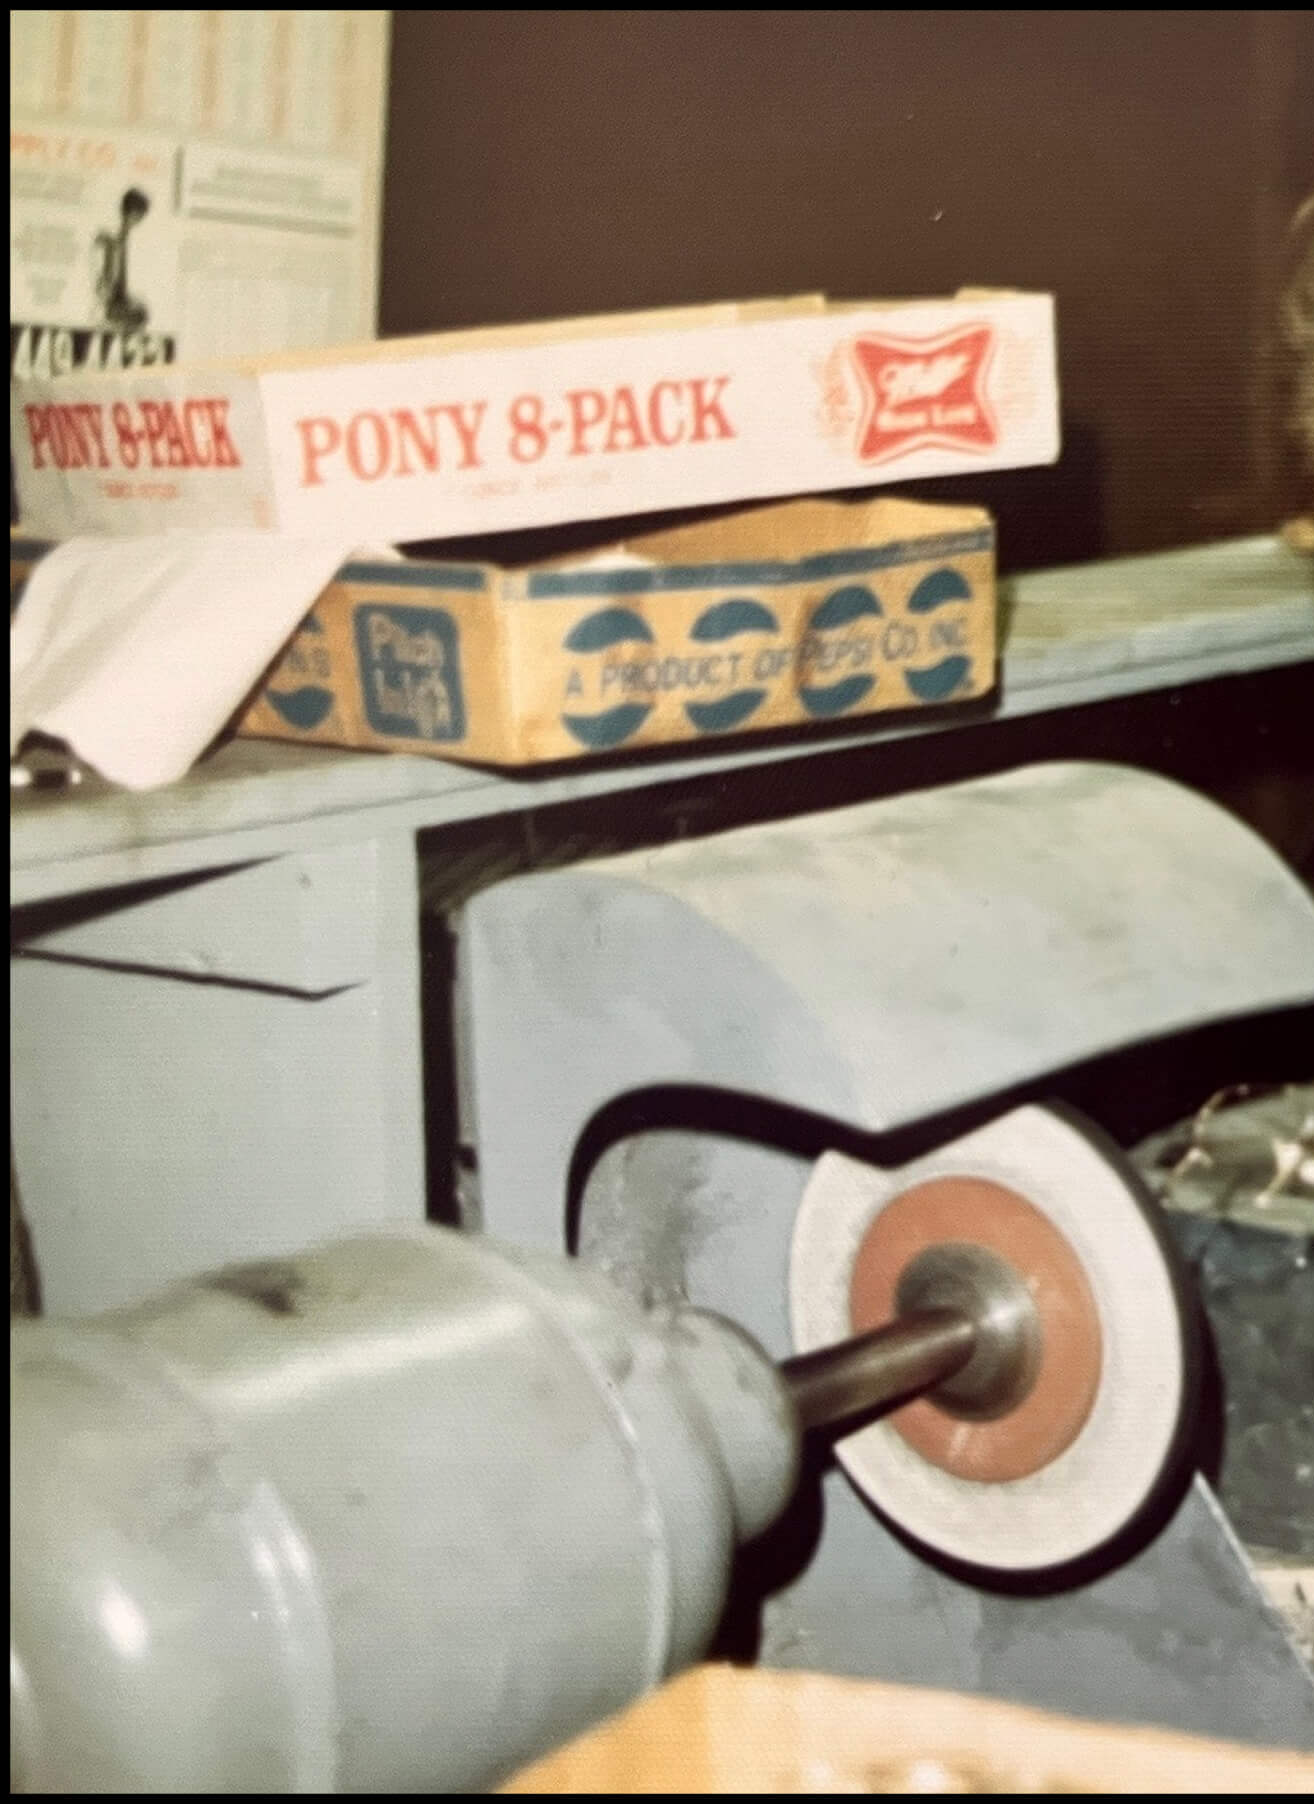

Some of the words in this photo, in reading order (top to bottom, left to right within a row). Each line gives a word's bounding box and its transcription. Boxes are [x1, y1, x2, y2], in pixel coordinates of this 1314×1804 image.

[26, 403, 111, 469] PONY
[112, 398, 242, 469] 8-PACK
[297, 403, 488, 487] PONY
[508, 377, 737, 463] 8-PACK
[565, 667, 583, 697] A
[601, 652, 741, 695] PRODUCT
[754, 648, 796, 681] OF
